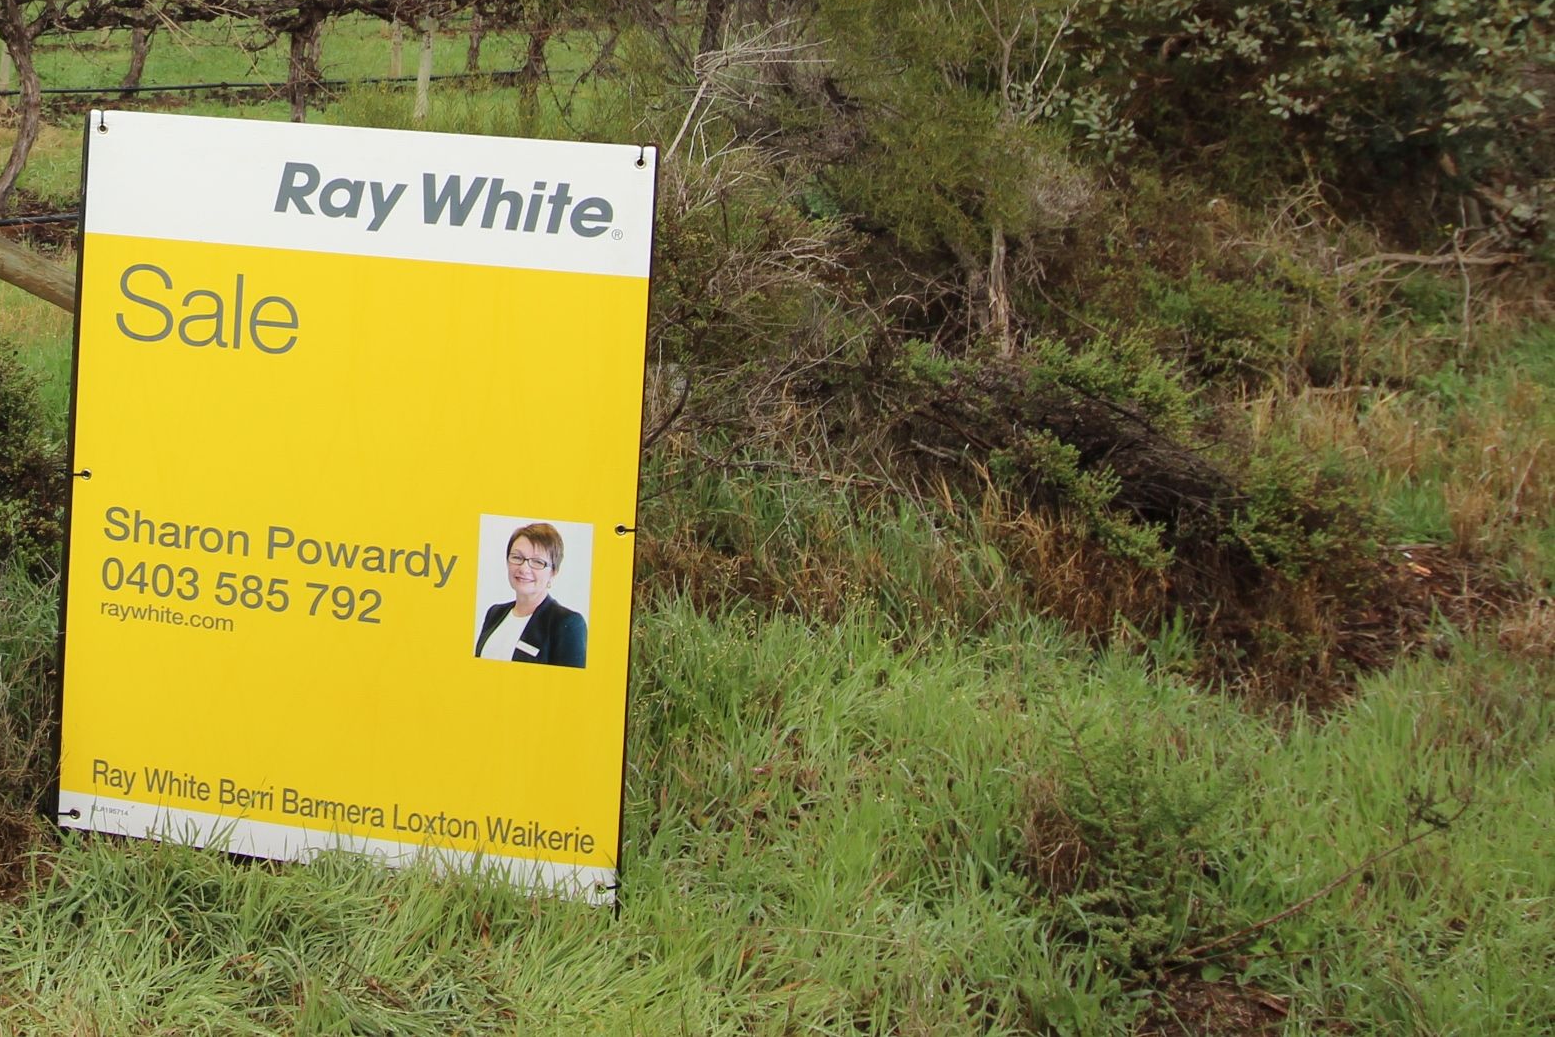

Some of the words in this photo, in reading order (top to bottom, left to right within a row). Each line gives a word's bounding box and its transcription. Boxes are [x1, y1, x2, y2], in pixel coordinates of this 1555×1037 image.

[274, 161, 407, 231] Ray
[422, 173, 614, 238] White
[116, 264, 299, 354] Sale
[103, 506, 250, 557] Sharon
[266, 526, 458, 589] Powardy
[100, 599, 235, 632] raywhite.com
[101, 557, 200, 602] 0403
[214, 572, 290, 613] 585
[306, 583, 383, 624] 792
[92, 759, 136, 795] Ray
[144, 767, 211, 801] White
[219, 778, 274, 811] Berri
[282, 788, 385, 828] Barmera
[393, 804, 478, 841] Loxton
[486, 816, 595, 855] Waikerie
